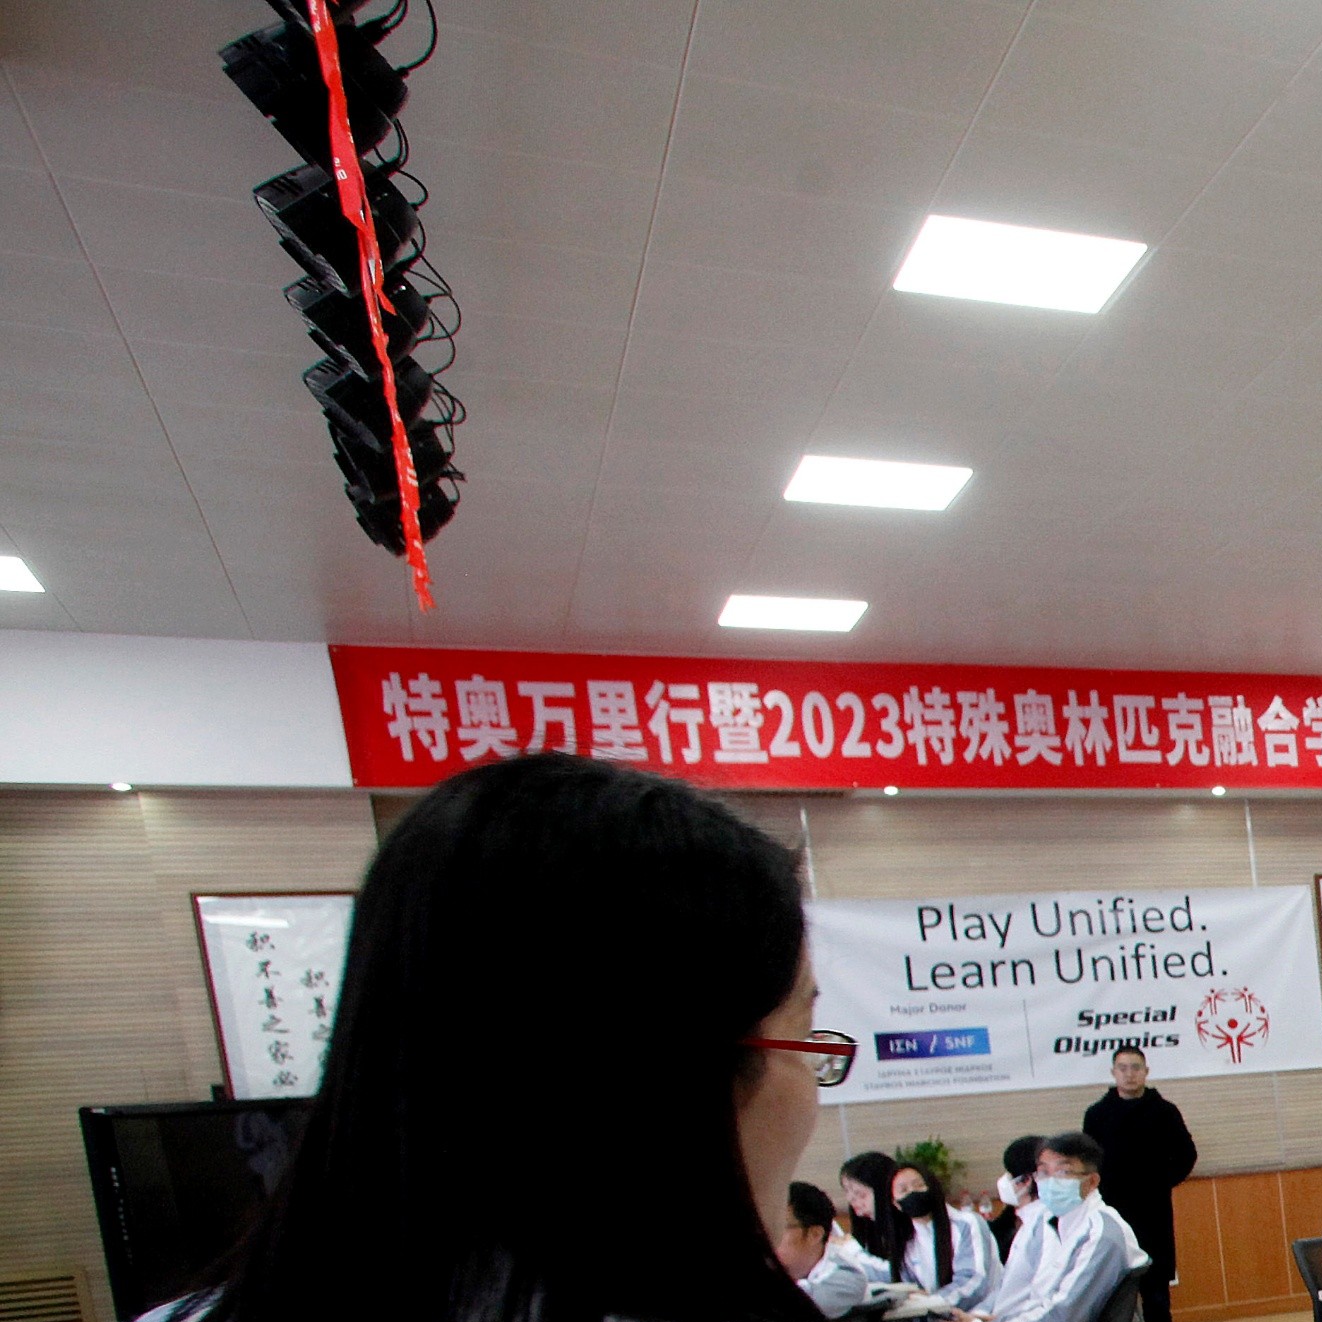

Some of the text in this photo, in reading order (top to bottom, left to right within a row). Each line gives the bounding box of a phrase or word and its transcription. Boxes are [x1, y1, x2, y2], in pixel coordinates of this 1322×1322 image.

[917, 895, 1209, 949] Play Unified.
[904, 941, 1229, 992] Learn Unified.
[890, 1002, 967, 1016] Major Donor
[1077, 1005, 1177, 1030] Special
[945, 1035, 976, 1049] SNF
[1053, 1032, 1180, 1057] Olympics
